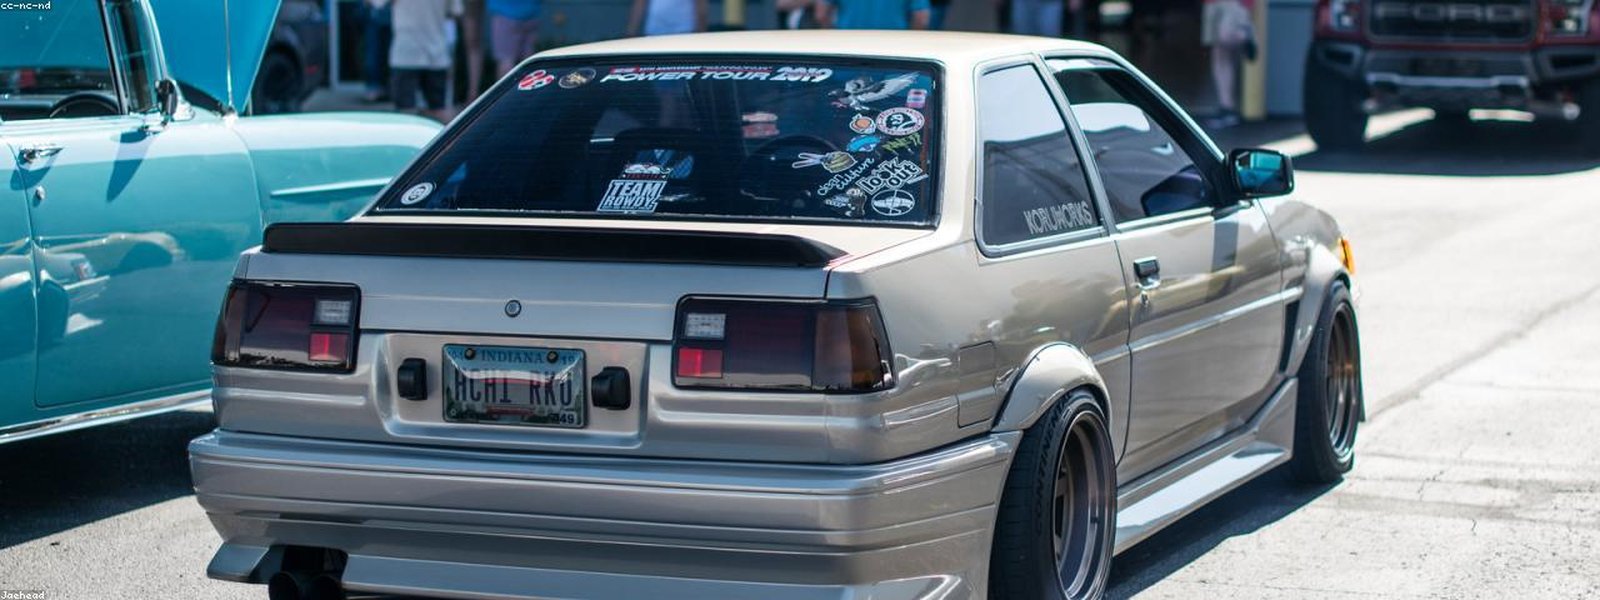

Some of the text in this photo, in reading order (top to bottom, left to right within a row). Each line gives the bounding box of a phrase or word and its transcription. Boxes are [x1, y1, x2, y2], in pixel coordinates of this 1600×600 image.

[1374, 3, 1523, 22] FORD
[600, 71, 697, 83] POWER
[700, 71, 772, 80] TOUR
[769, 66, 833, 83] 2019
[886, 162, 920, 188] out
[610, 182, 661, 196] TEAM
[1023, 200, 1092, 235] KORUWORKS
[481, 350, 545, 364] INDIANA
[560, 413, 575, 424] 49
